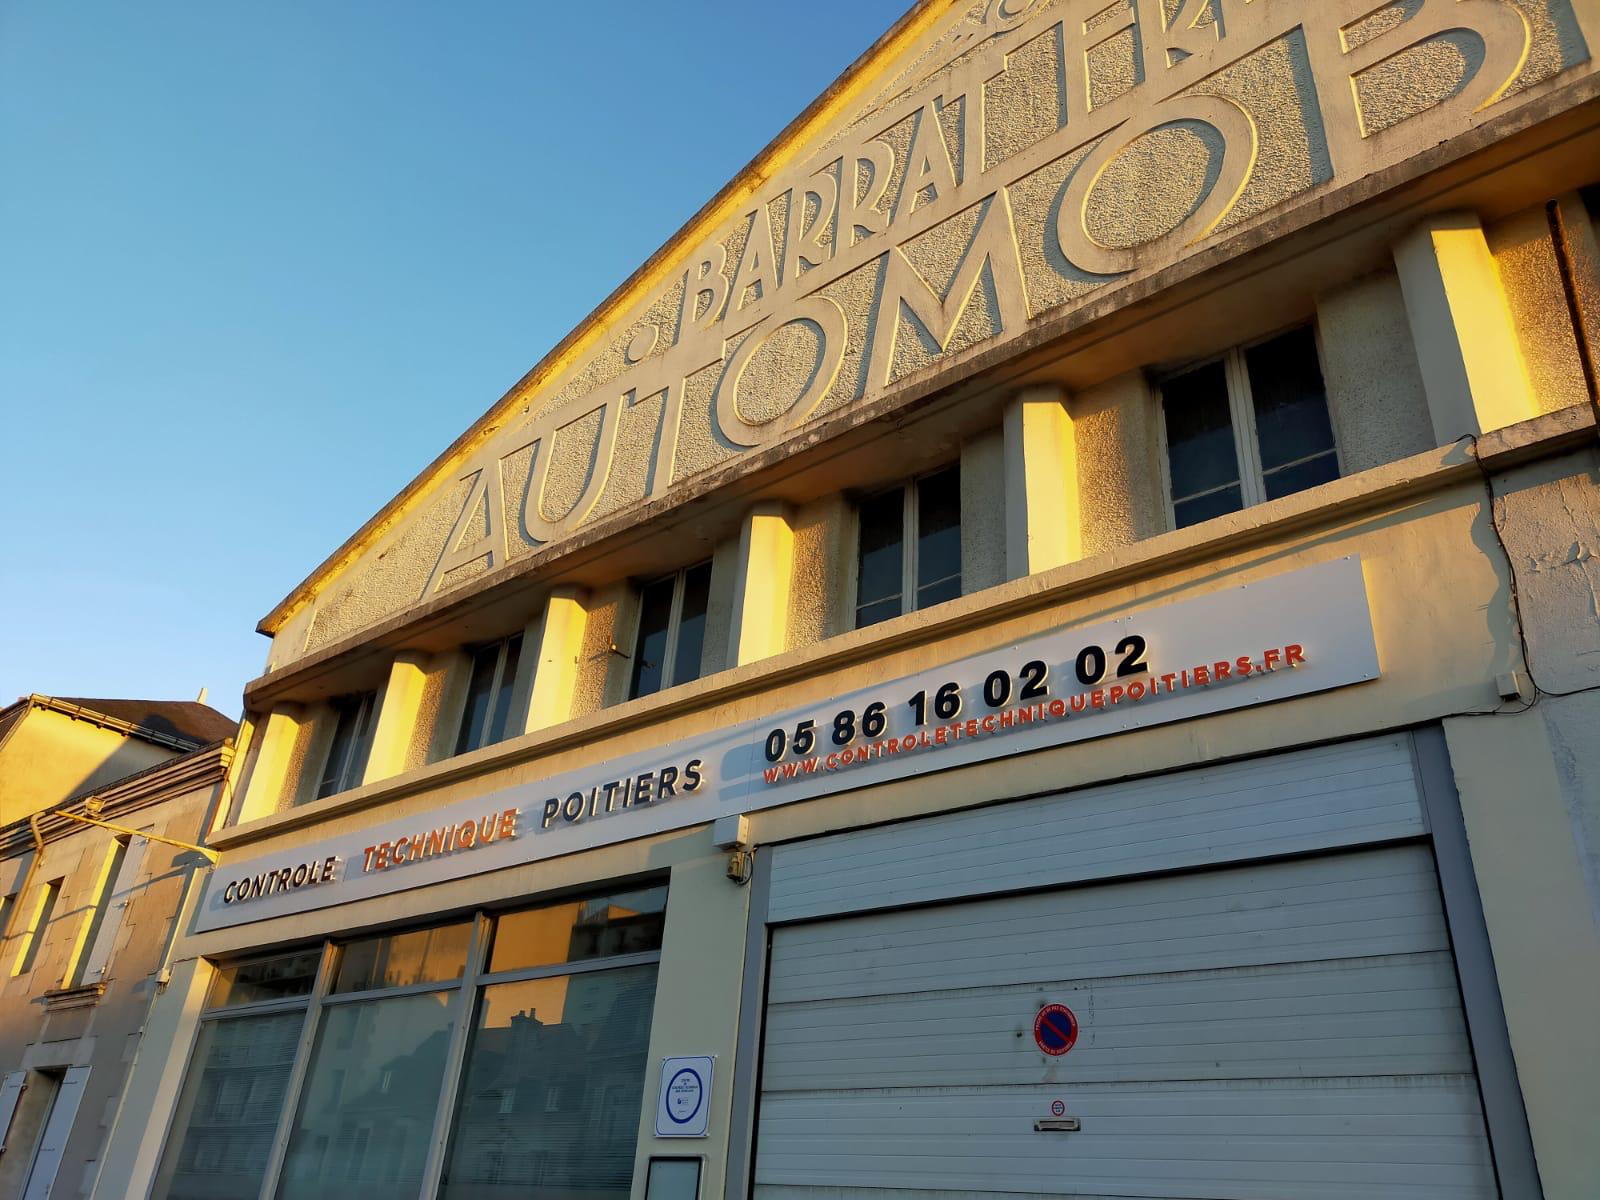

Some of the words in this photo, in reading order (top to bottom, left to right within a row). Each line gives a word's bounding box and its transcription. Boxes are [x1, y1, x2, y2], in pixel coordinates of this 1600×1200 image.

[673, 52, 1008, 347] BARRAT
[762, 643, 1307, 785] WWW.CONTROLETECHNIQUEPOITIERS.FR
[764, 719, 817, 763] 05
[831, 701, 887, 747] 86
[907, 681, 964, 727] 16
[982, 660, 1049, 708] 02
[1074, 634, 1149, 686] 02
[223, 855, 343, 905] CONTROLE
[362, 807, 521, 873] TECHNIQUE
[541, 758, 705, 830] POITIERS
